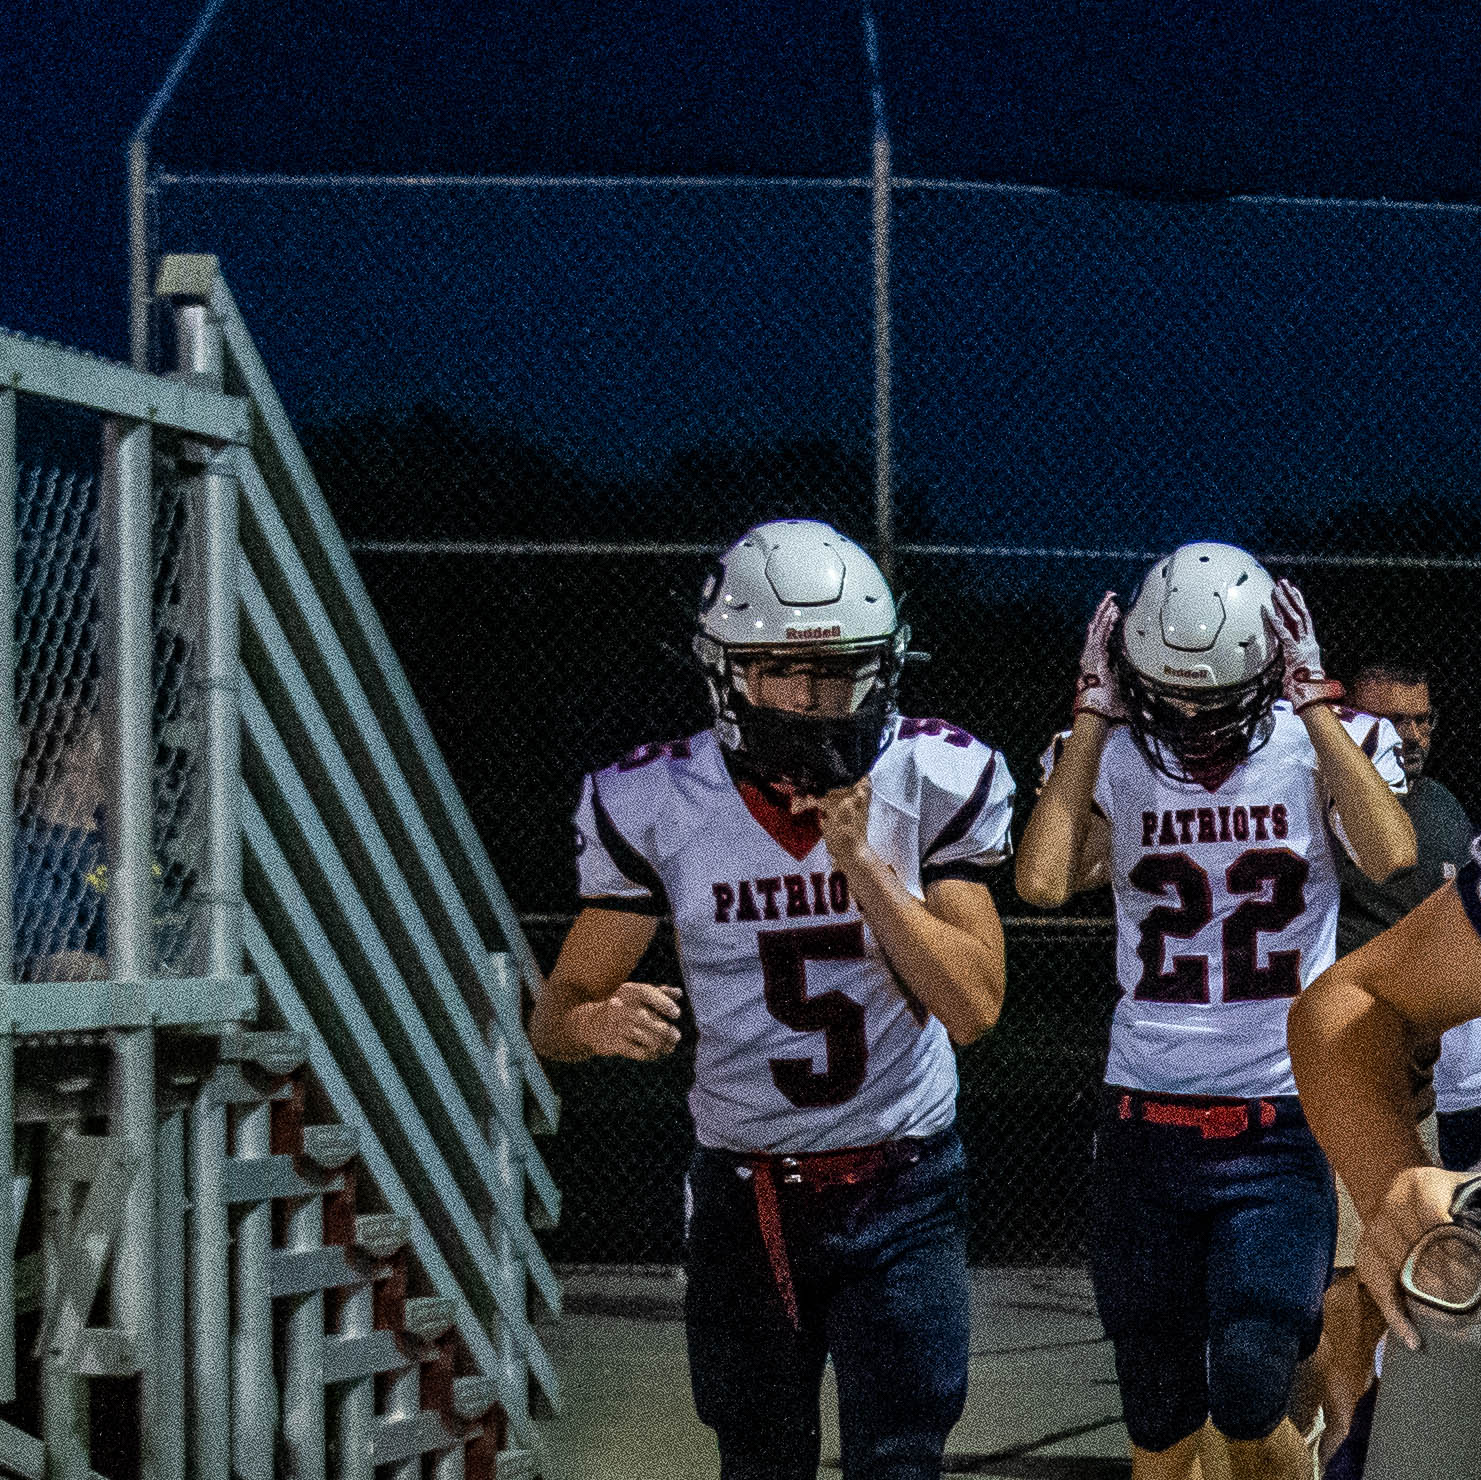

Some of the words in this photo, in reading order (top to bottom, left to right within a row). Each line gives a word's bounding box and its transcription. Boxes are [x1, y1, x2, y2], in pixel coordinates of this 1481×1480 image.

[1141, 803, 1289, 847] PATRIOTS
[712, 870, 862, 923] PATRIO
[1127, 846, 1310, 1003] 22
[757, 920, 868, 1107] 5
